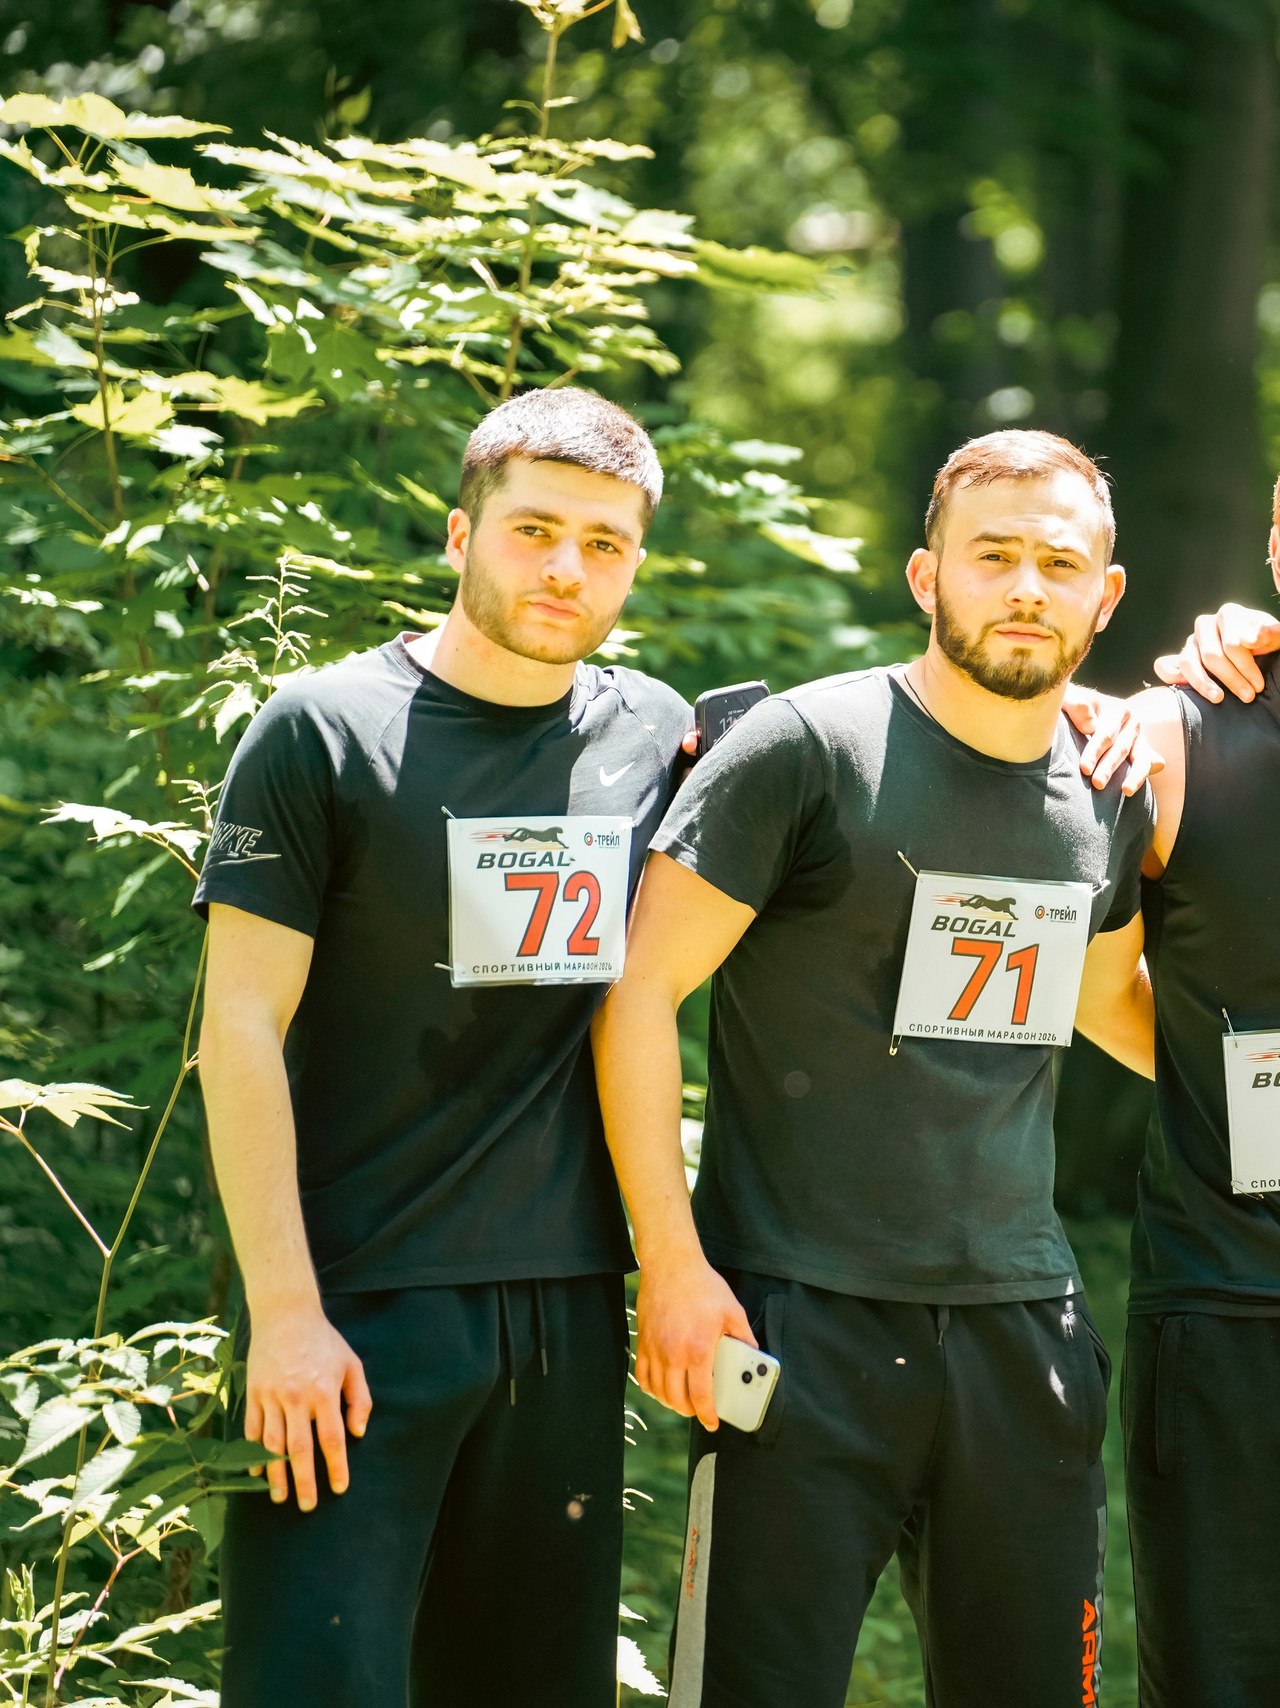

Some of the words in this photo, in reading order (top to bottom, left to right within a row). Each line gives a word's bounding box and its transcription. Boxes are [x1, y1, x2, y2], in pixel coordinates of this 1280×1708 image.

[476, 851, 571, 869] BOGAL
[503, 870, 602, 958] 72
[930, 915, 1016, 938] BOGAL
[472, 962, 561, 974] СПОРТИВНЫЙ
[564, 962, 598, 972] МАРАФОН
[947, 936, 1040, 1026] 71
[908, 1023, 984, 1038] СПОРТИВНЫЙ
[987, 1030, 1036, 1041] МАРАФОН
[1038, 1032, 1057, 1042] 2026
[1082, 1599, 1096, 1708] ARM
